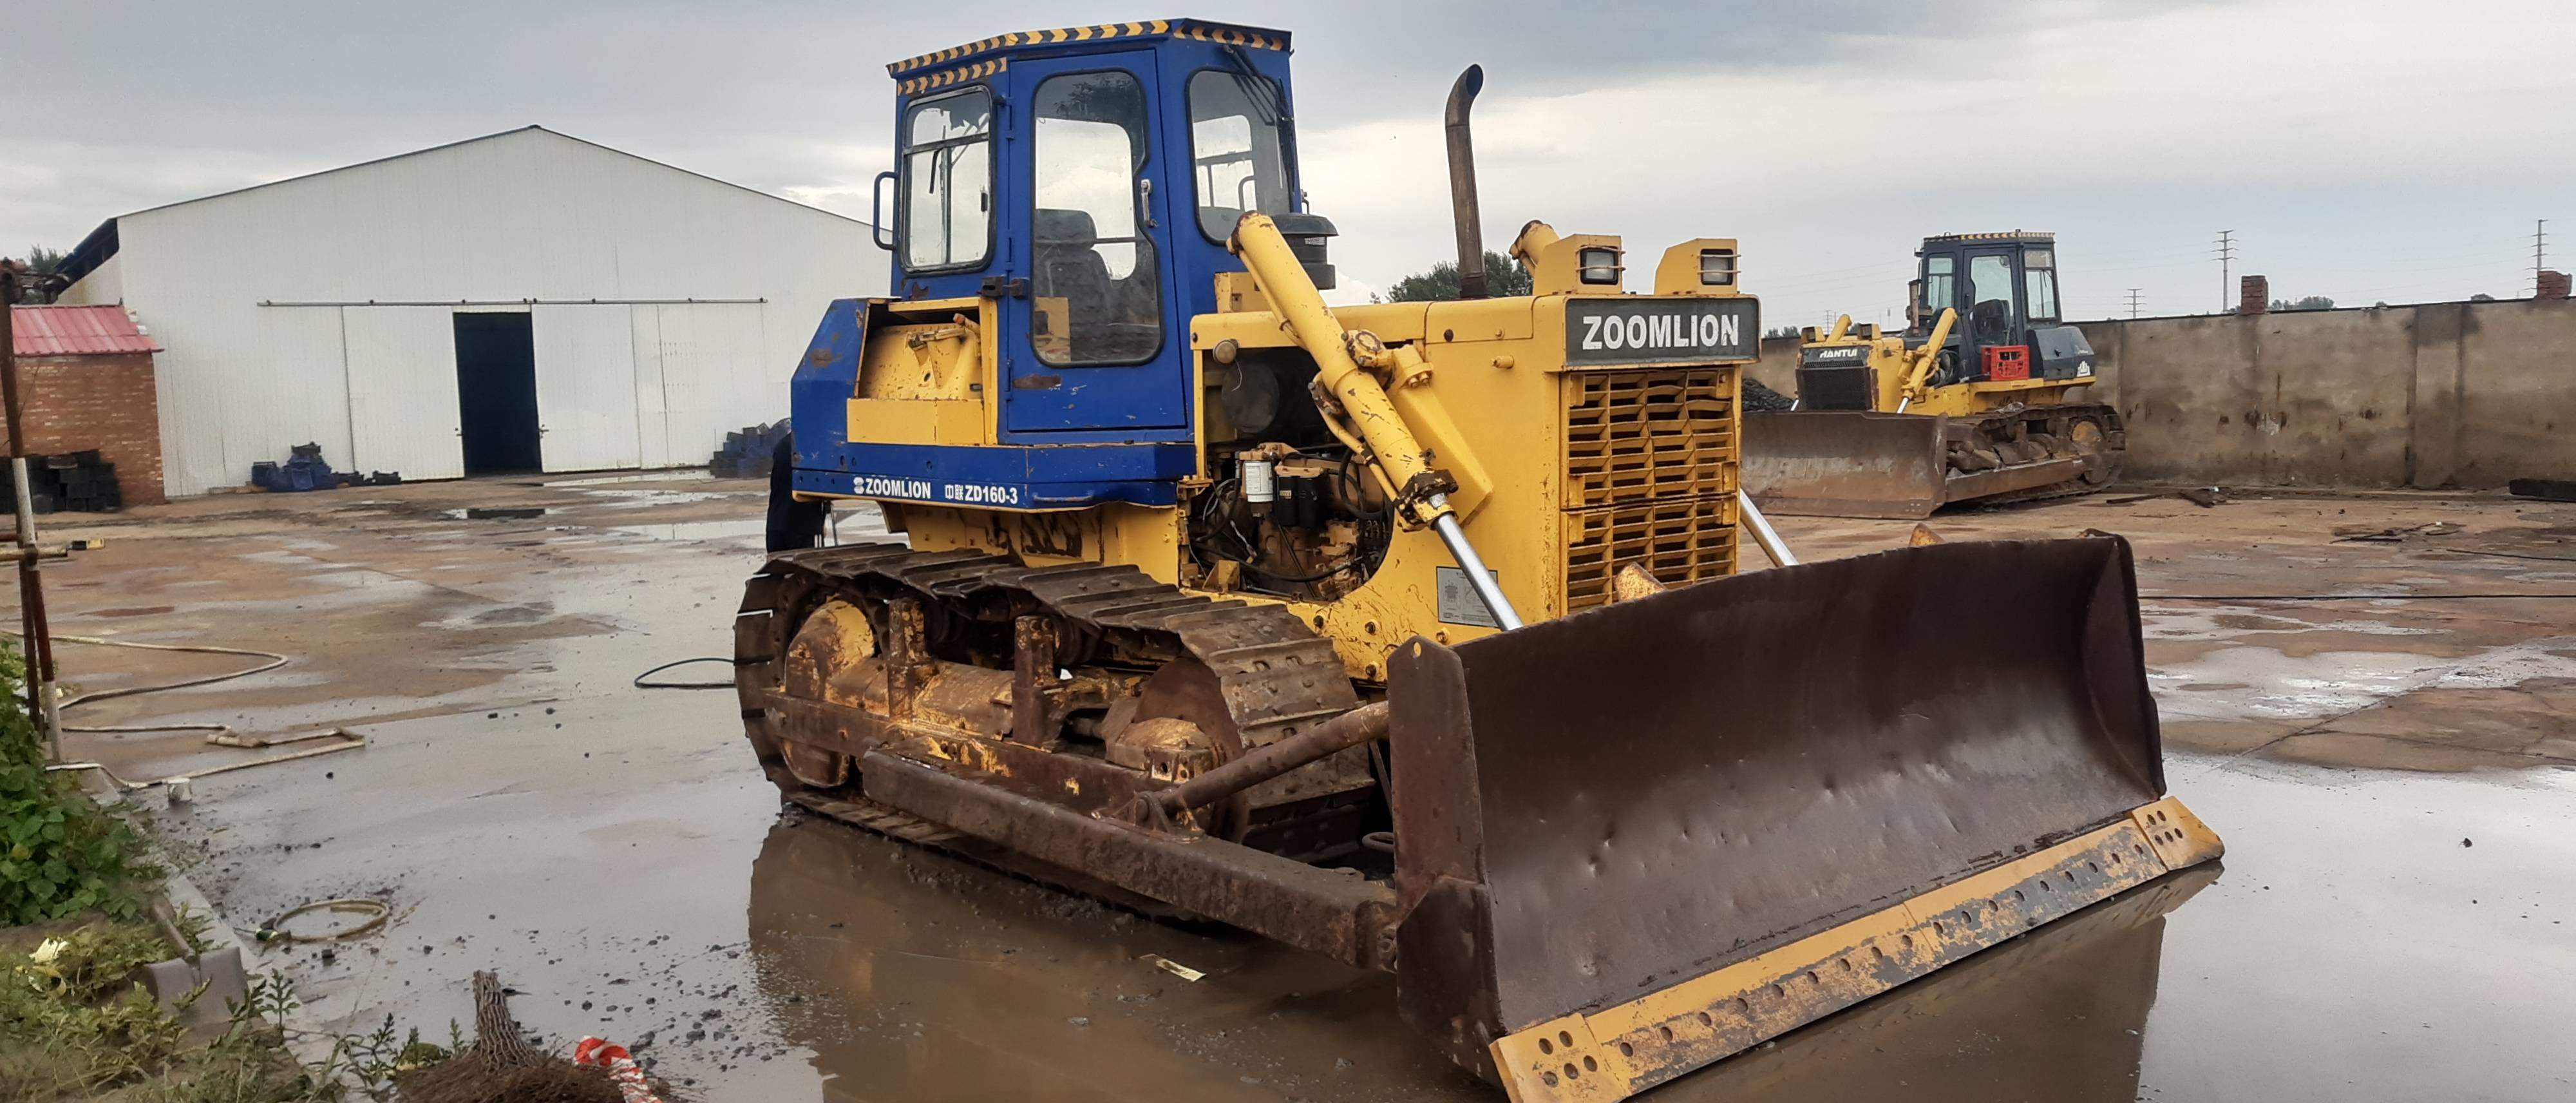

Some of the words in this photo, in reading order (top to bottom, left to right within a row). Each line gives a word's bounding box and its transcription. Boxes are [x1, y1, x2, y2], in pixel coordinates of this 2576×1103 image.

[1582, 314, 1738, 350] ZOOMLION
[866, 478, 931, 499] ZOOMLION
[965, 484, 1018, 504] ZD160-3
